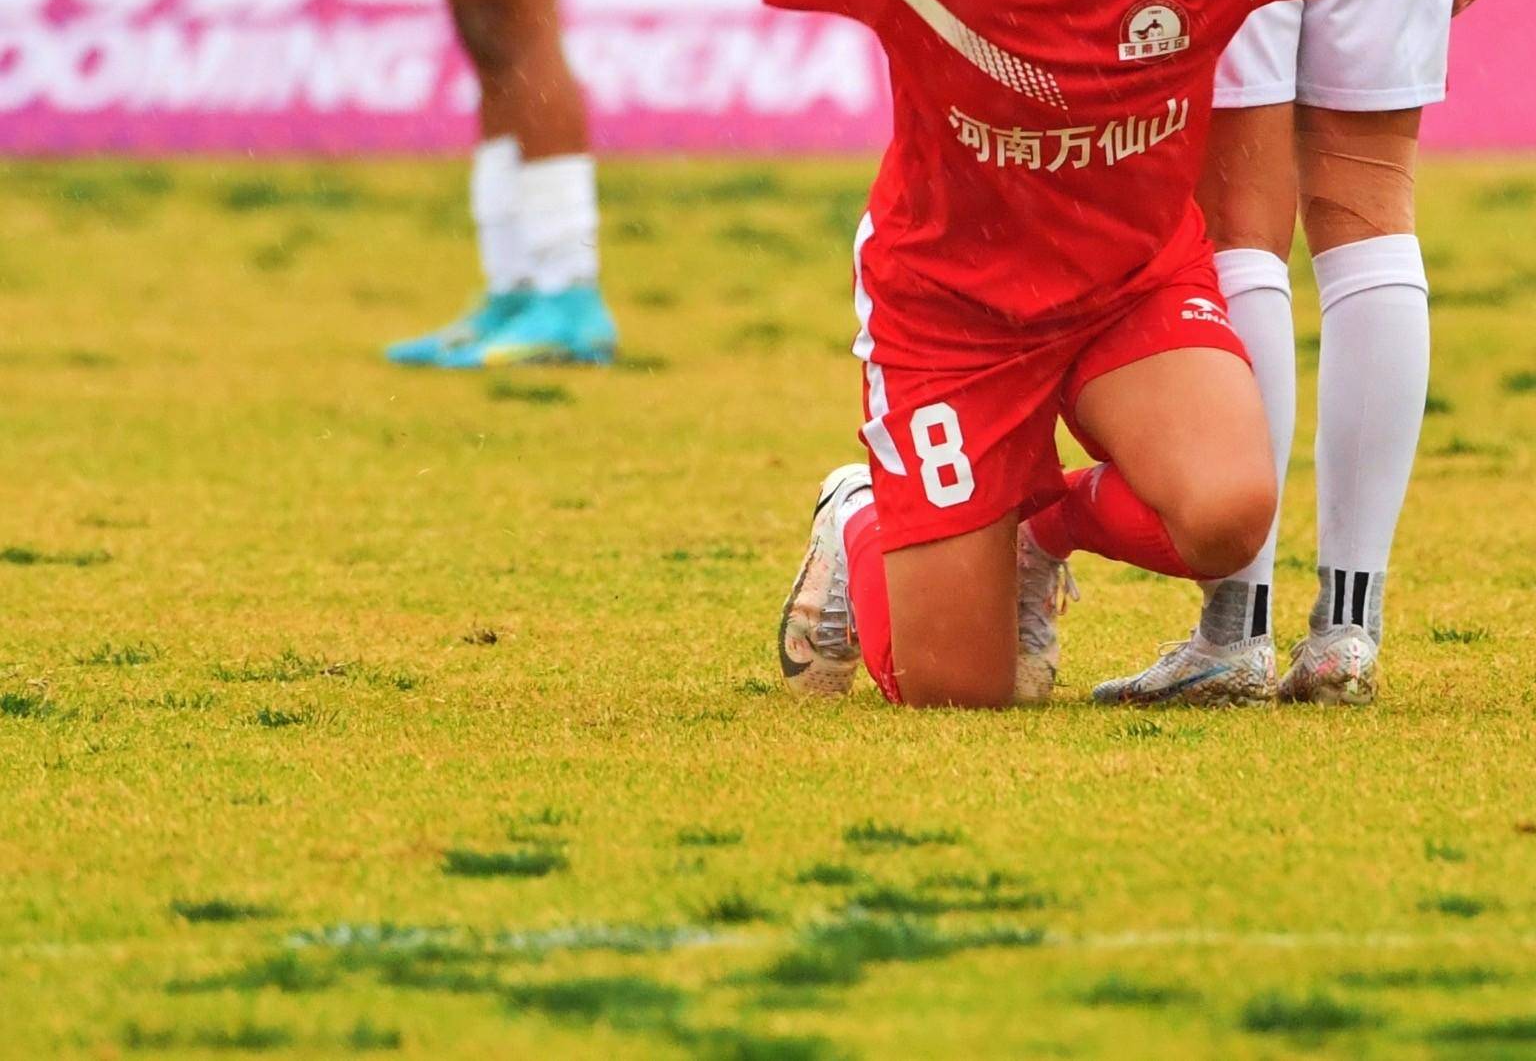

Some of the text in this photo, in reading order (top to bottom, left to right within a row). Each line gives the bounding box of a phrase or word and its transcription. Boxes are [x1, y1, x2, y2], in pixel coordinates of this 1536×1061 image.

[948, 97, 1190, 173] 河南万仙山
[910, 402, 975, 508] 8
